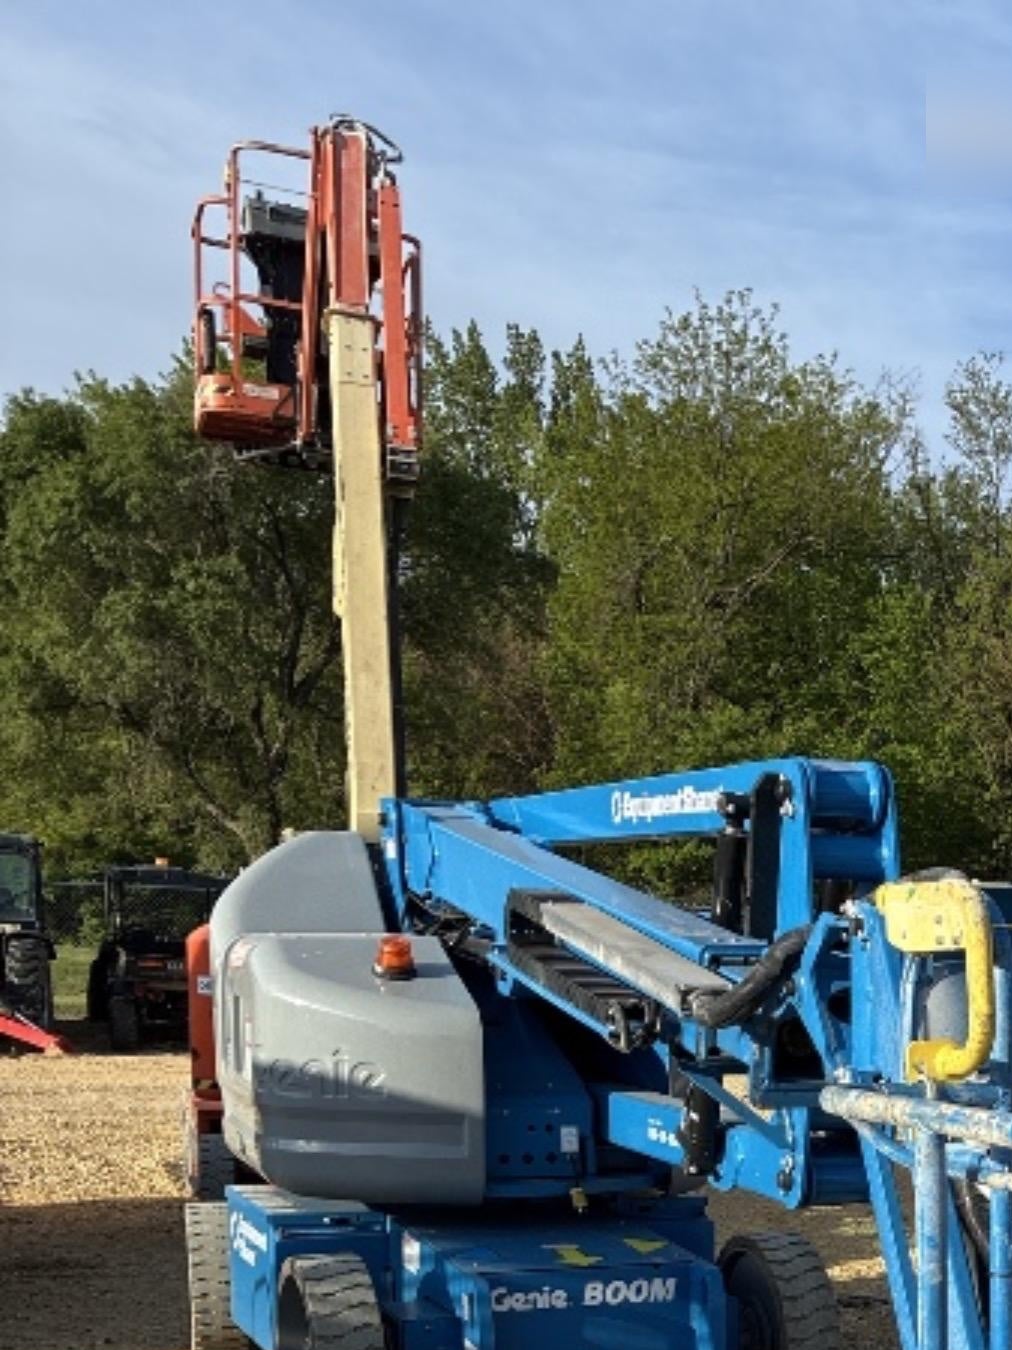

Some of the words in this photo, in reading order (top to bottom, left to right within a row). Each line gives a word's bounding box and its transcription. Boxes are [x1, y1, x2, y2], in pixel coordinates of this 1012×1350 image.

[252, 1047, 387, 1098] enie
[491, 1286, 569, 1312] Genie
[582, 1277, 678, 1307] BOOM
